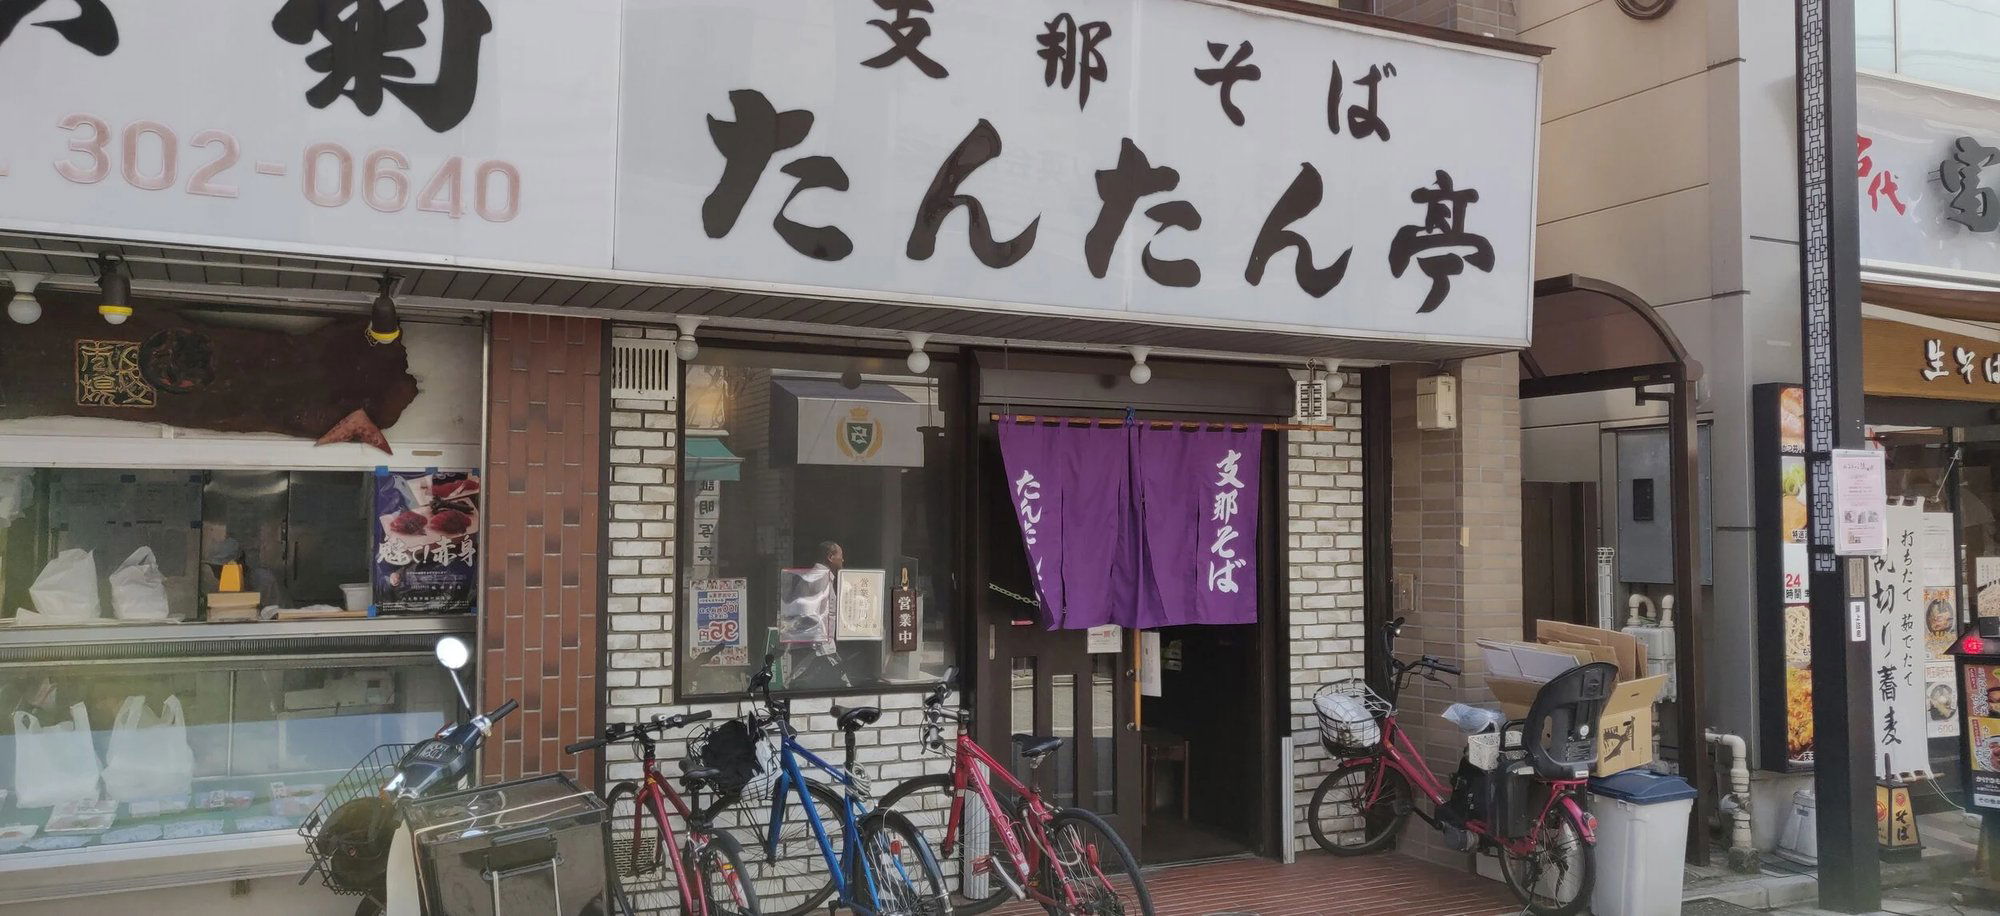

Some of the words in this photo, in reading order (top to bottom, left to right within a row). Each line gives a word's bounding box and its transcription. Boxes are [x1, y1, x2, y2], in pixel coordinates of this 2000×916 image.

[860, 0, 1397, 142] 支那そば
[53, 112, 521, 223] 302-0640
[702, 89, 1496, 313] たんたん亭
[1016, 470, 1043, 592] たんた
[1208, 449, 1247, 594] 支那そば
[897, 596, 912, 645] 営業中
[1785, 573, 1801, 588] 24
[1895, 809, 1910, 841] そば
